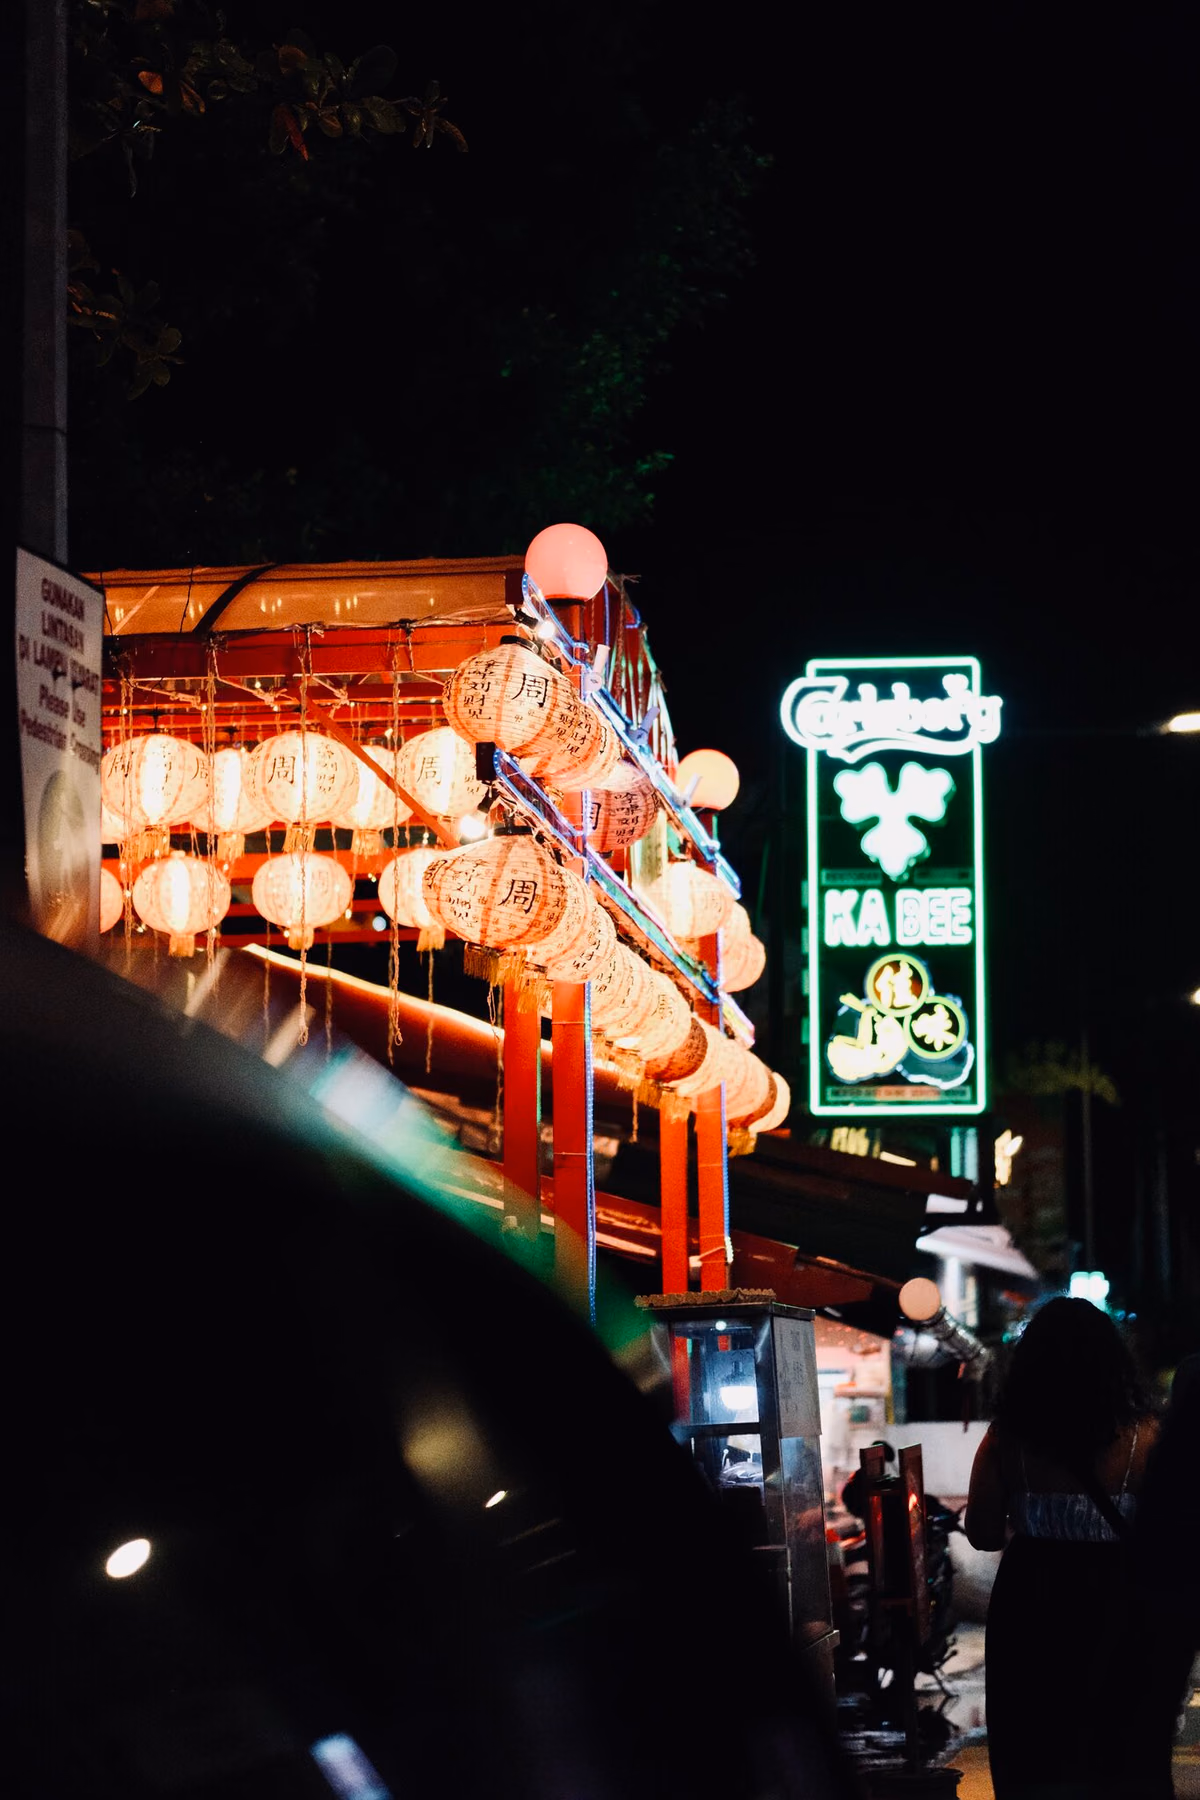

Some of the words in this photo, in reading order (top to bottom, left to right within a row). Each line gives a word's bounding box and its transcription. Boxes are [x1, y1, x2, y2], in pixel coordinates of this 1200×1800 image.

[512, 673, 549, 708] 周
[267, 755, 296, 784] 周
[498, 879, 537, 914] 周
[824, 889, 891, 946] KA
[895, 887, 973, 945] BEE
